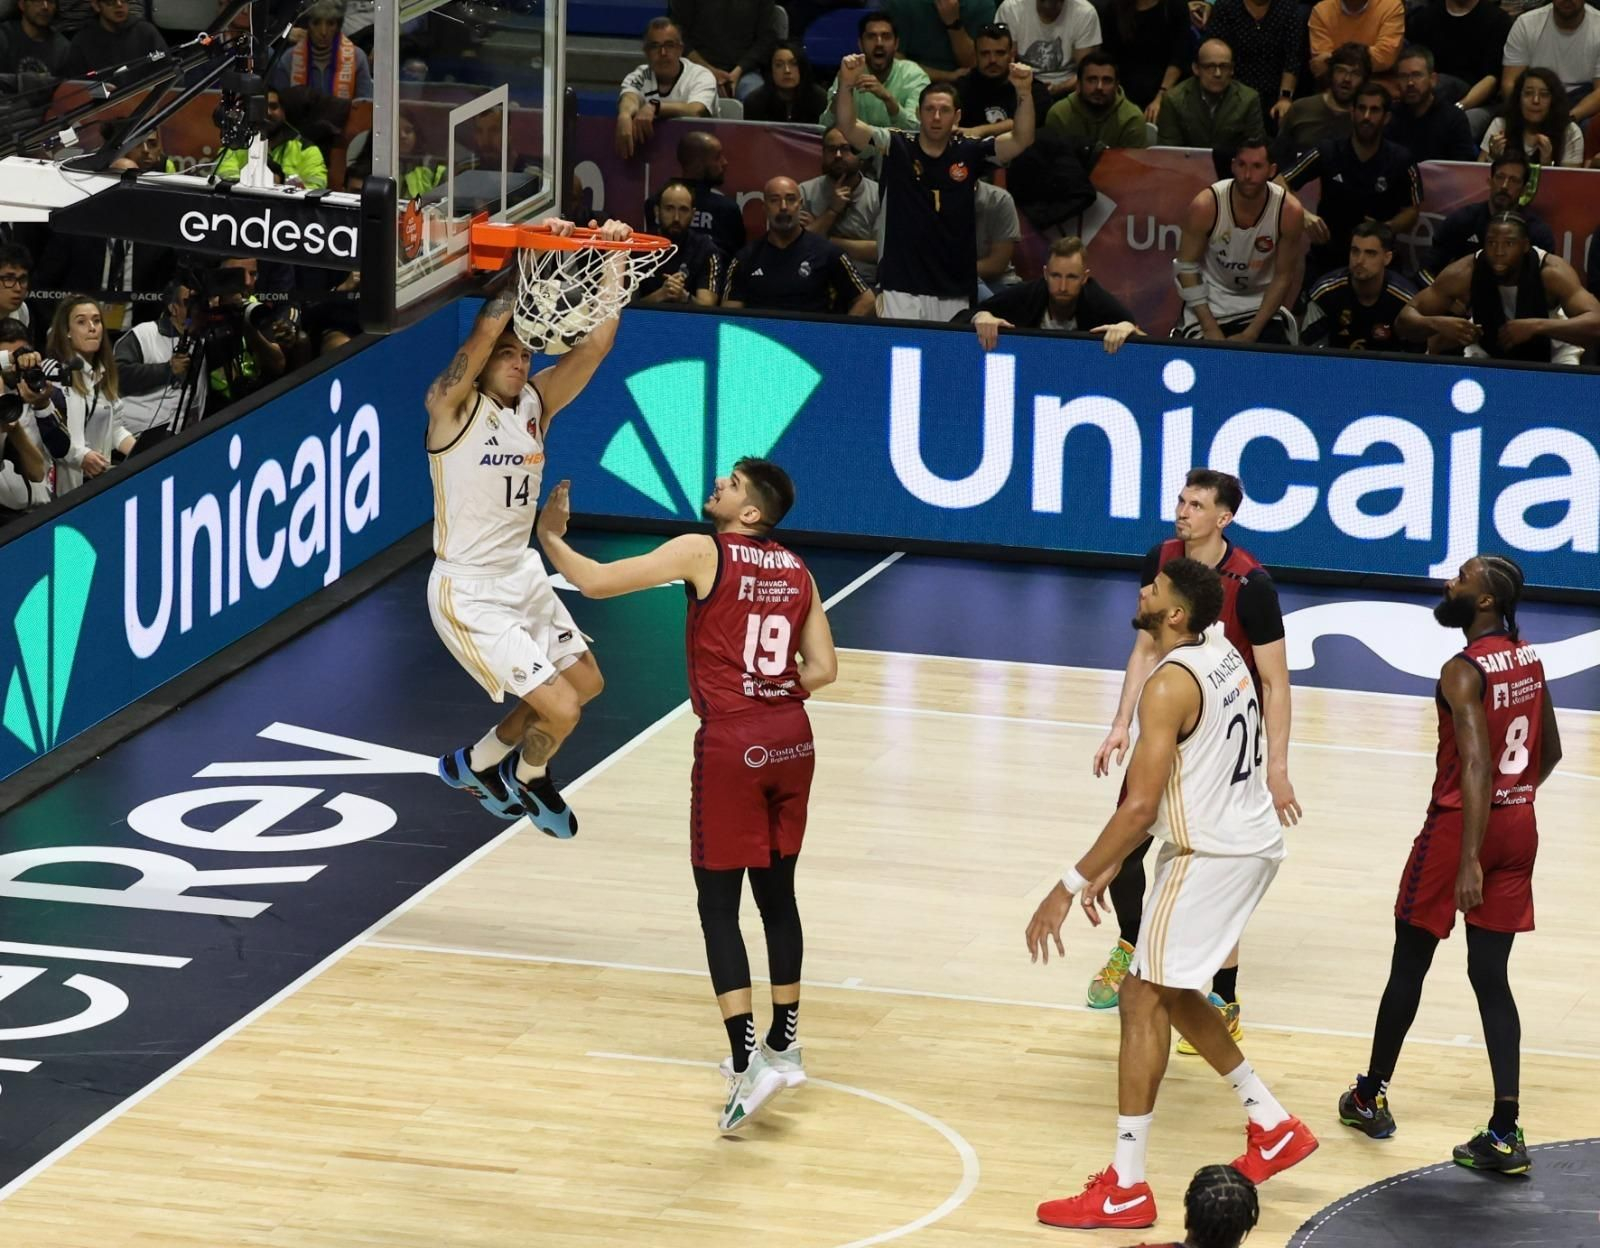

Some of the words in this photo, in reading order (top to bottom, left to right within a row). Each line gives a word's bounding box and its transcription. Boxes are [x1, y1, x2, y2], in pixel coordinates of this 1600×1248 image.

[180, 208, 358, 257] endesa
[503, 474, 530, 508] 14
[888, 346, 1600, 580] Unicaja
[124, 378, 381, 660] Unicaja
[743, 614, 791, 676] 19
[770, 747, 794, 758] Costa
[1498, 714, 1530, 775] 8
